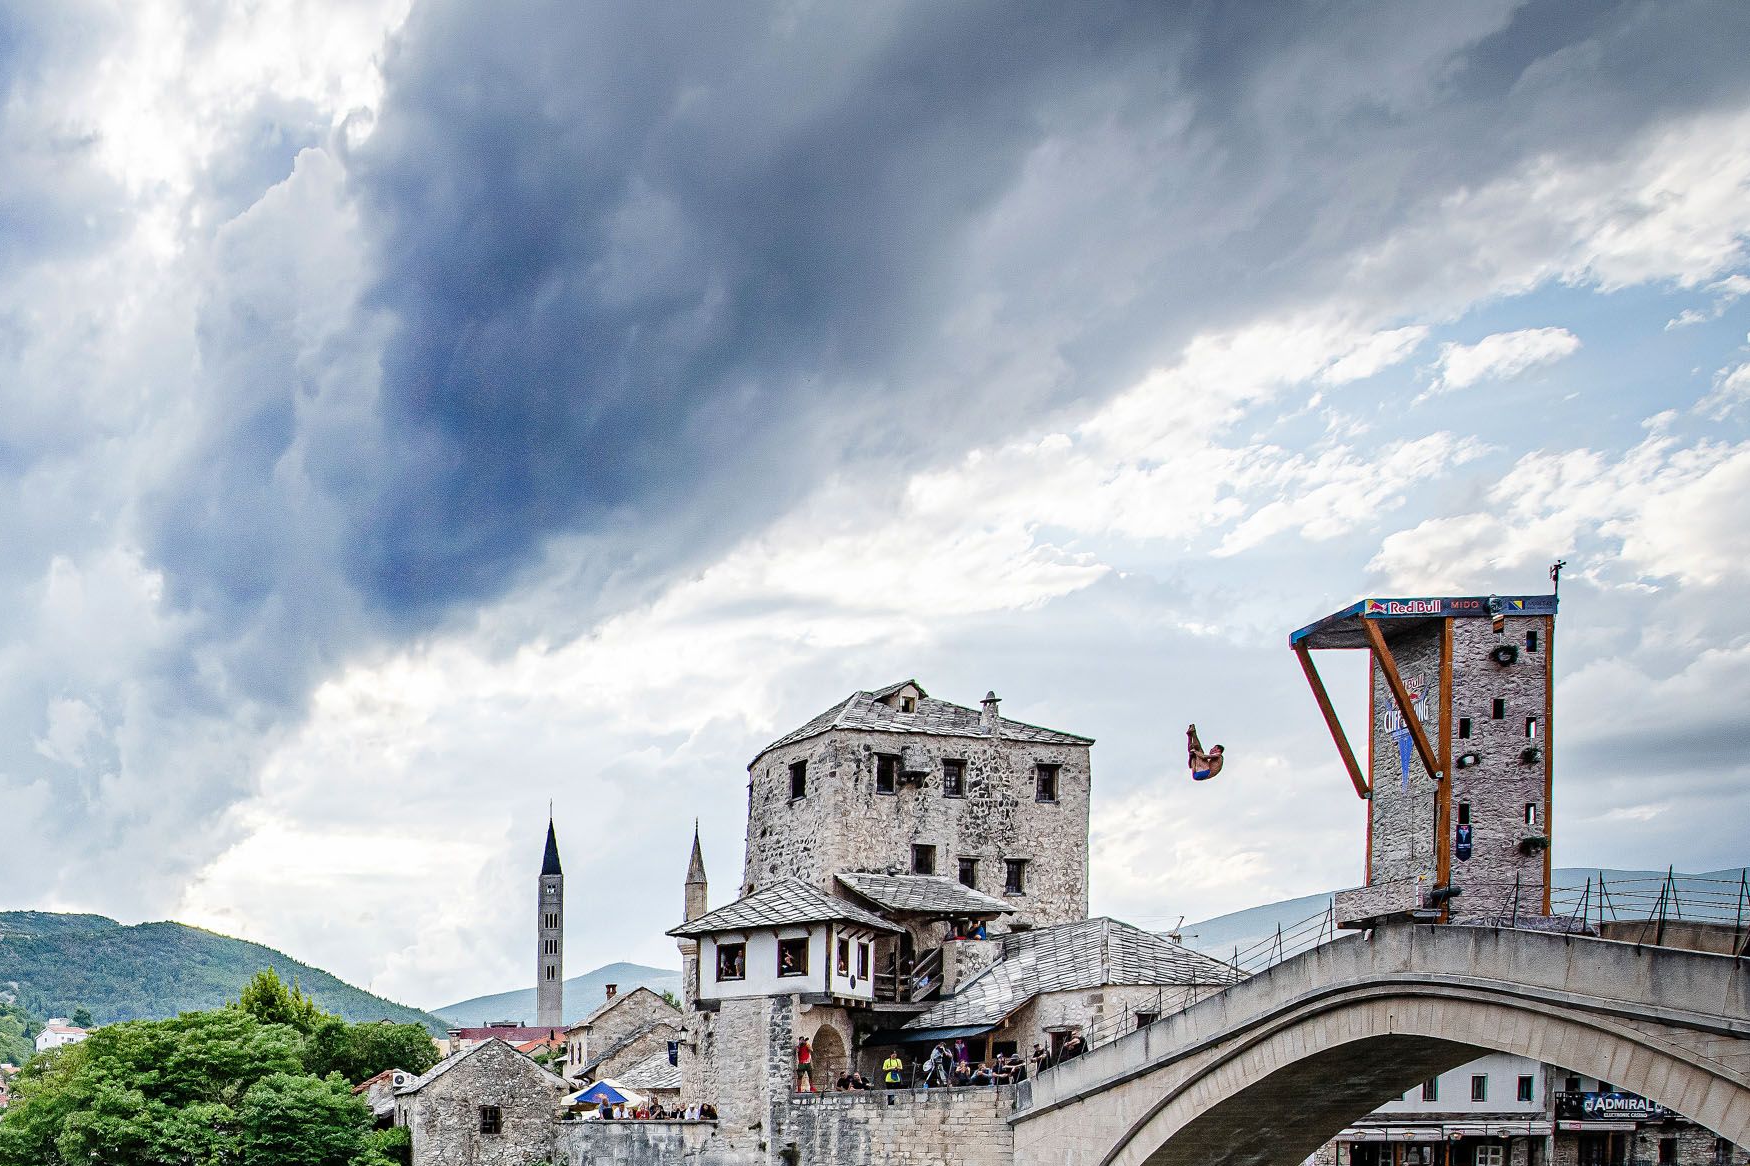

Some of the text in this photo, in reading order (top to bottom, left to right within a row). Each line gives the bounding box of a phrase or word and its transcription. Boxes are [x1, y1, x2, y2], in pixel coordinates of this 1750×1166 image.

[1390, 600, 1440, 613] Red Bull
[1450, 600, 1479, 609] MIDO
[1594, 1097, 1654, 1112] ADMIRAL
